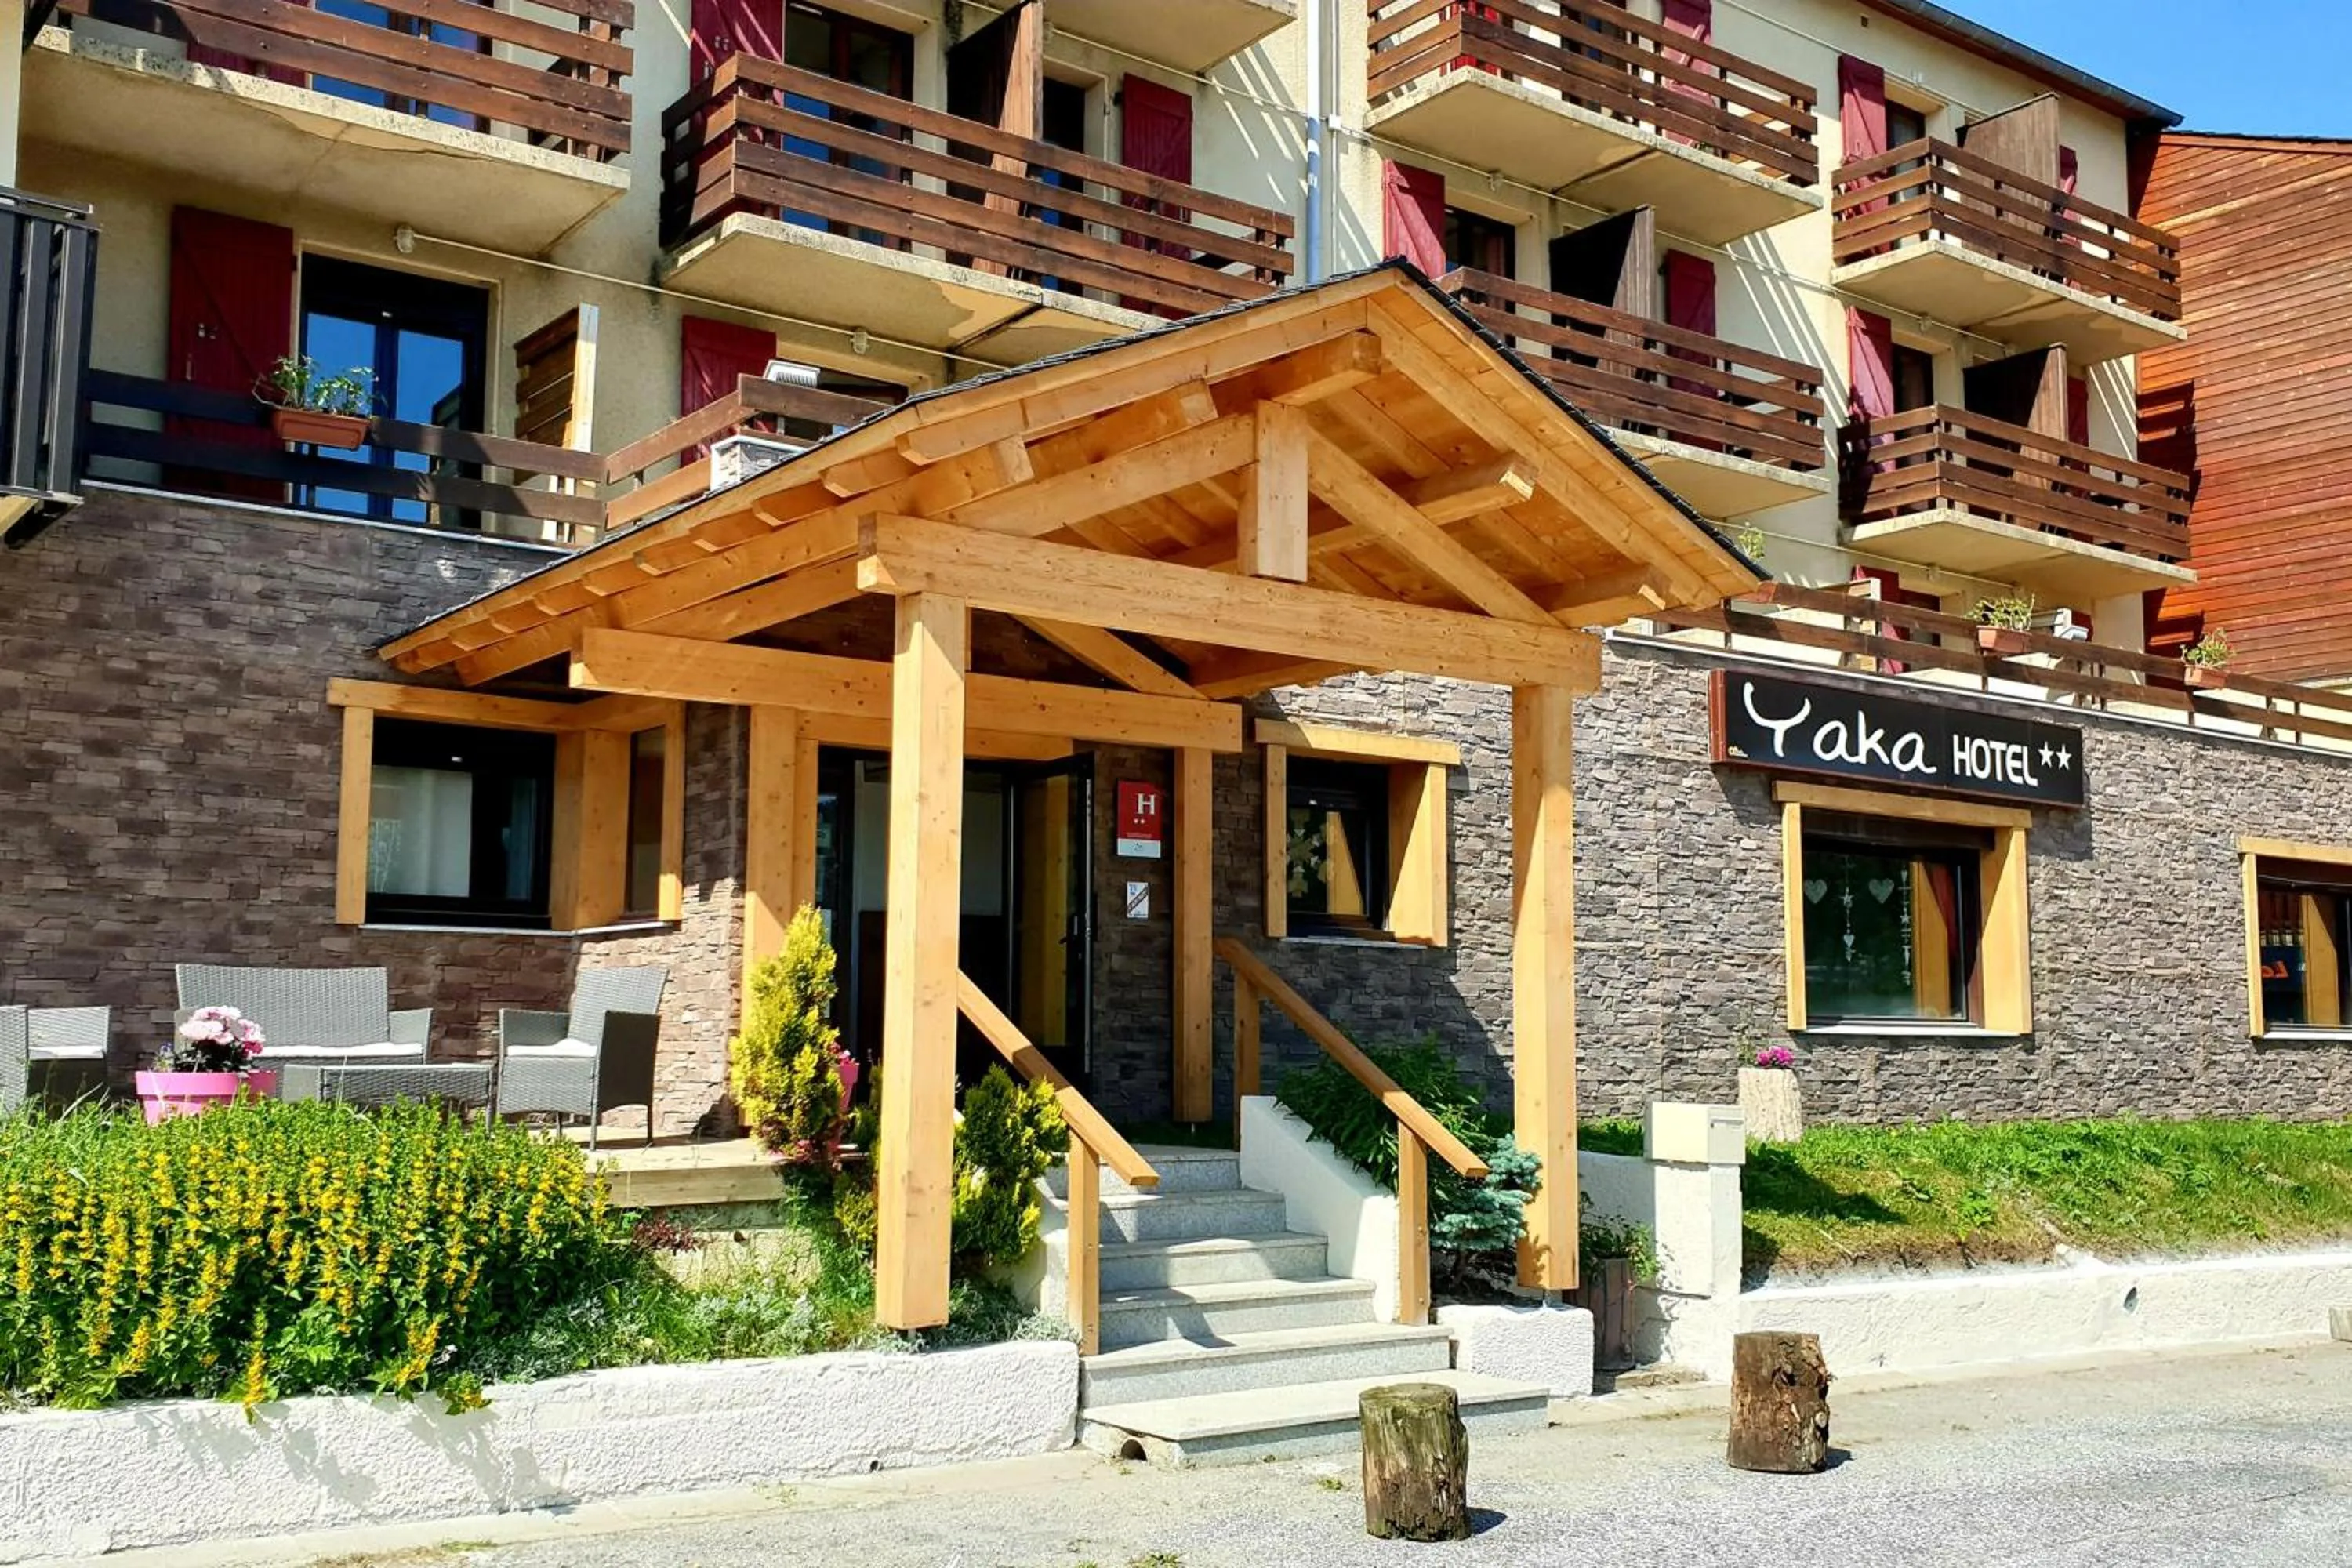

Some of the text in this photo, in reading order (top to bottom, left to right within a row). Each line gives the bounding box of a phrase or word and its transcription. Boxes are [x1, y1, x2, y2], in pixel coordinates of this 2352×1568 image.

[1743, 681, 2038, 786] Yaka HOTEL
[1137, 793, 1156, 815] H
